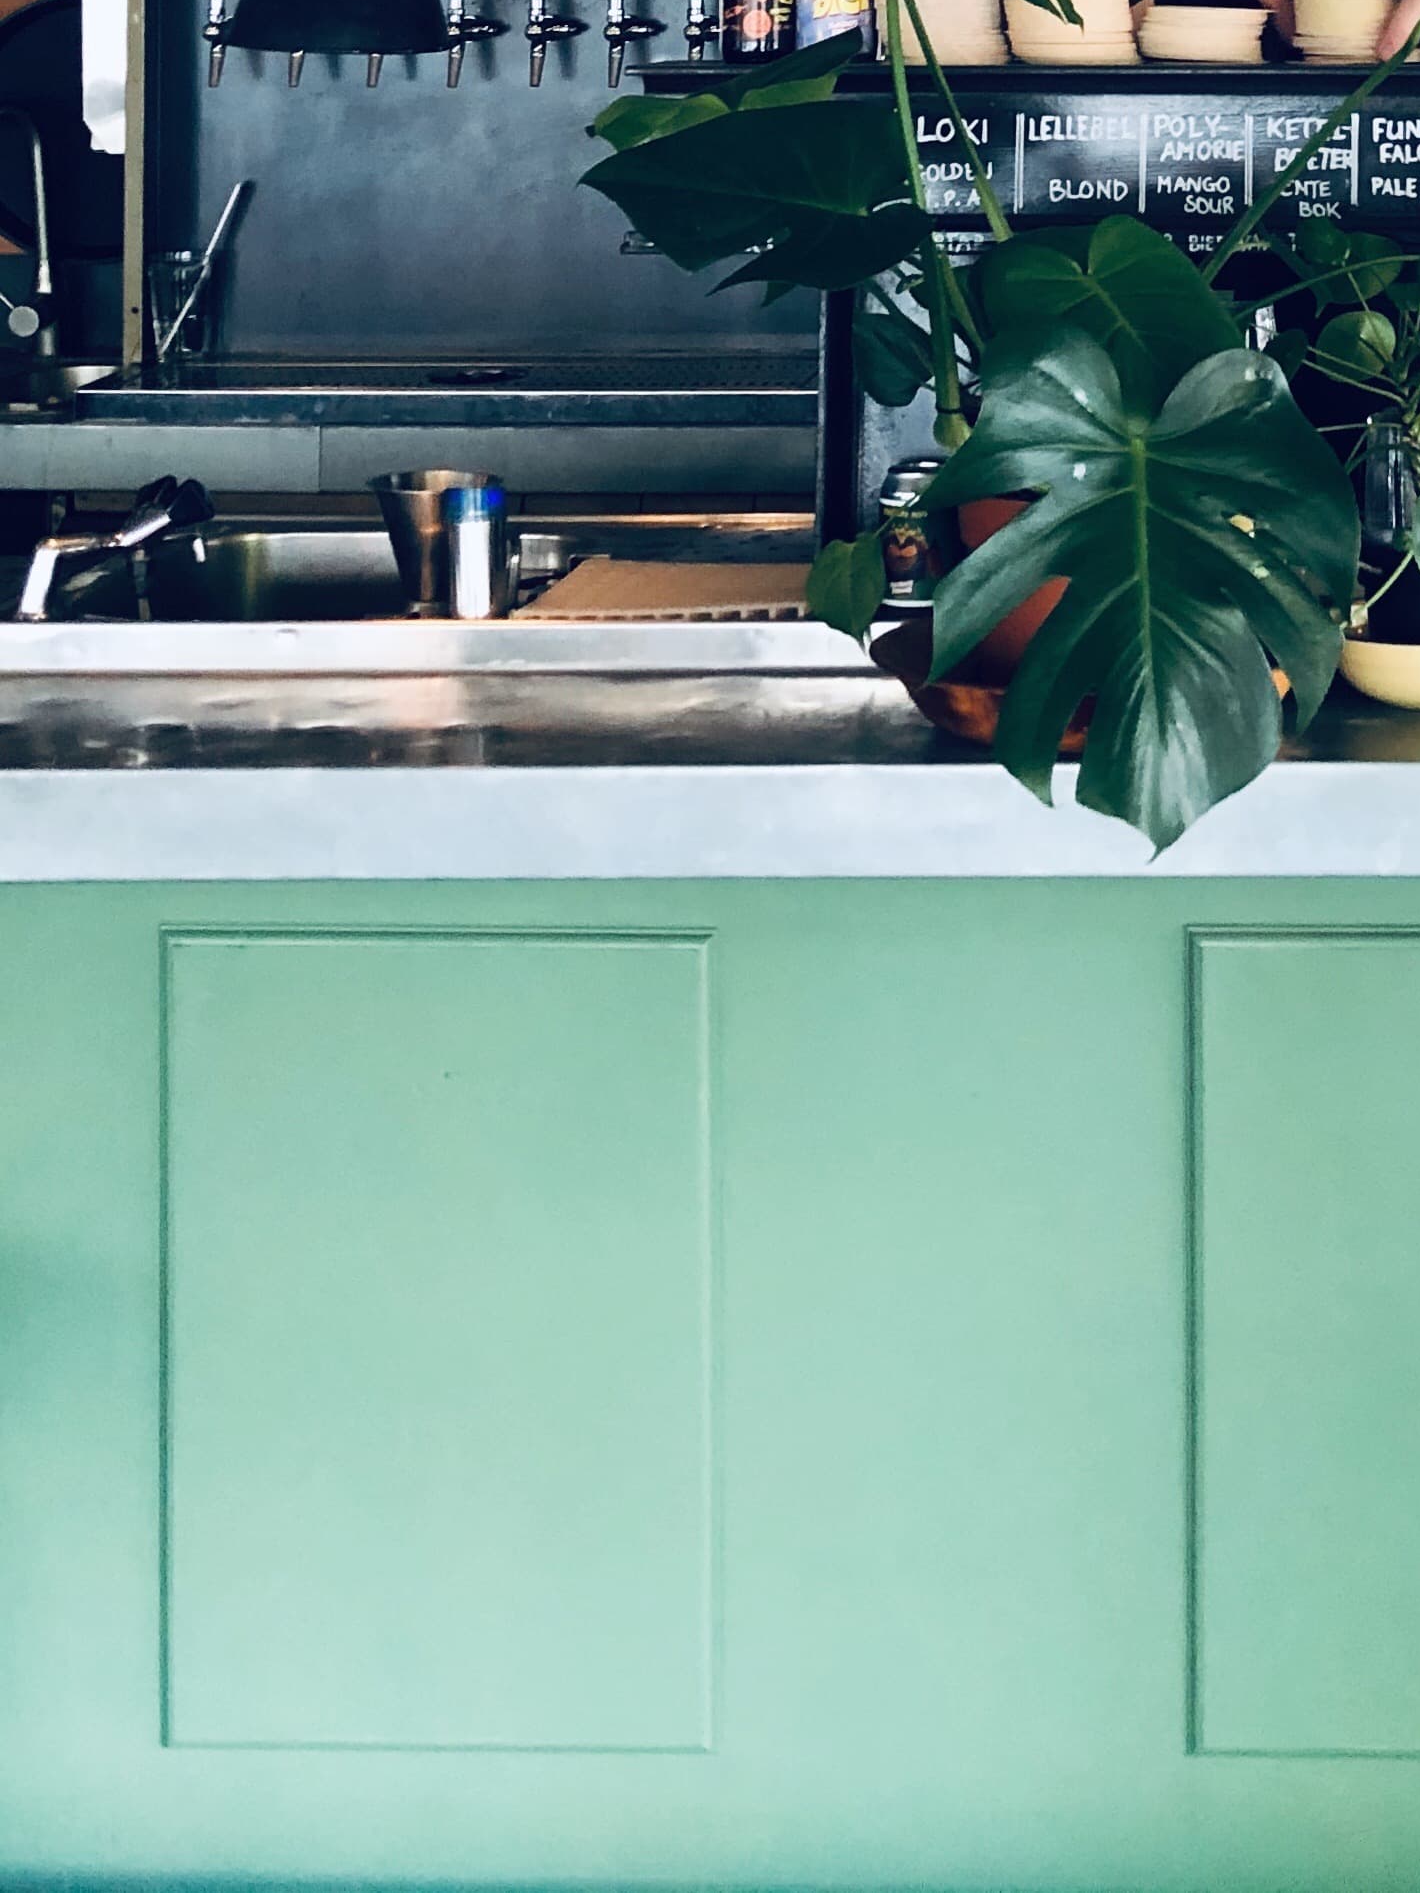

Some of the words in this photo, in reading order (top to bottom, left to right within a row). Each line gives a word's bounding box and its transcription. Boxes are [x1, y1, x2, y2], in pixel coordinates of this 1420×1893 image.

[1160, 139, 1246, 163] AMORIE
[1048, 178, 1130, 203] BLOND
[1156, 176, 1231, 195] MANGO
[1371, 176, 1418, 199] PALE
[1183, 195, 1235, 215] SOUR
[1299, 200, 1342, 219] BOK
